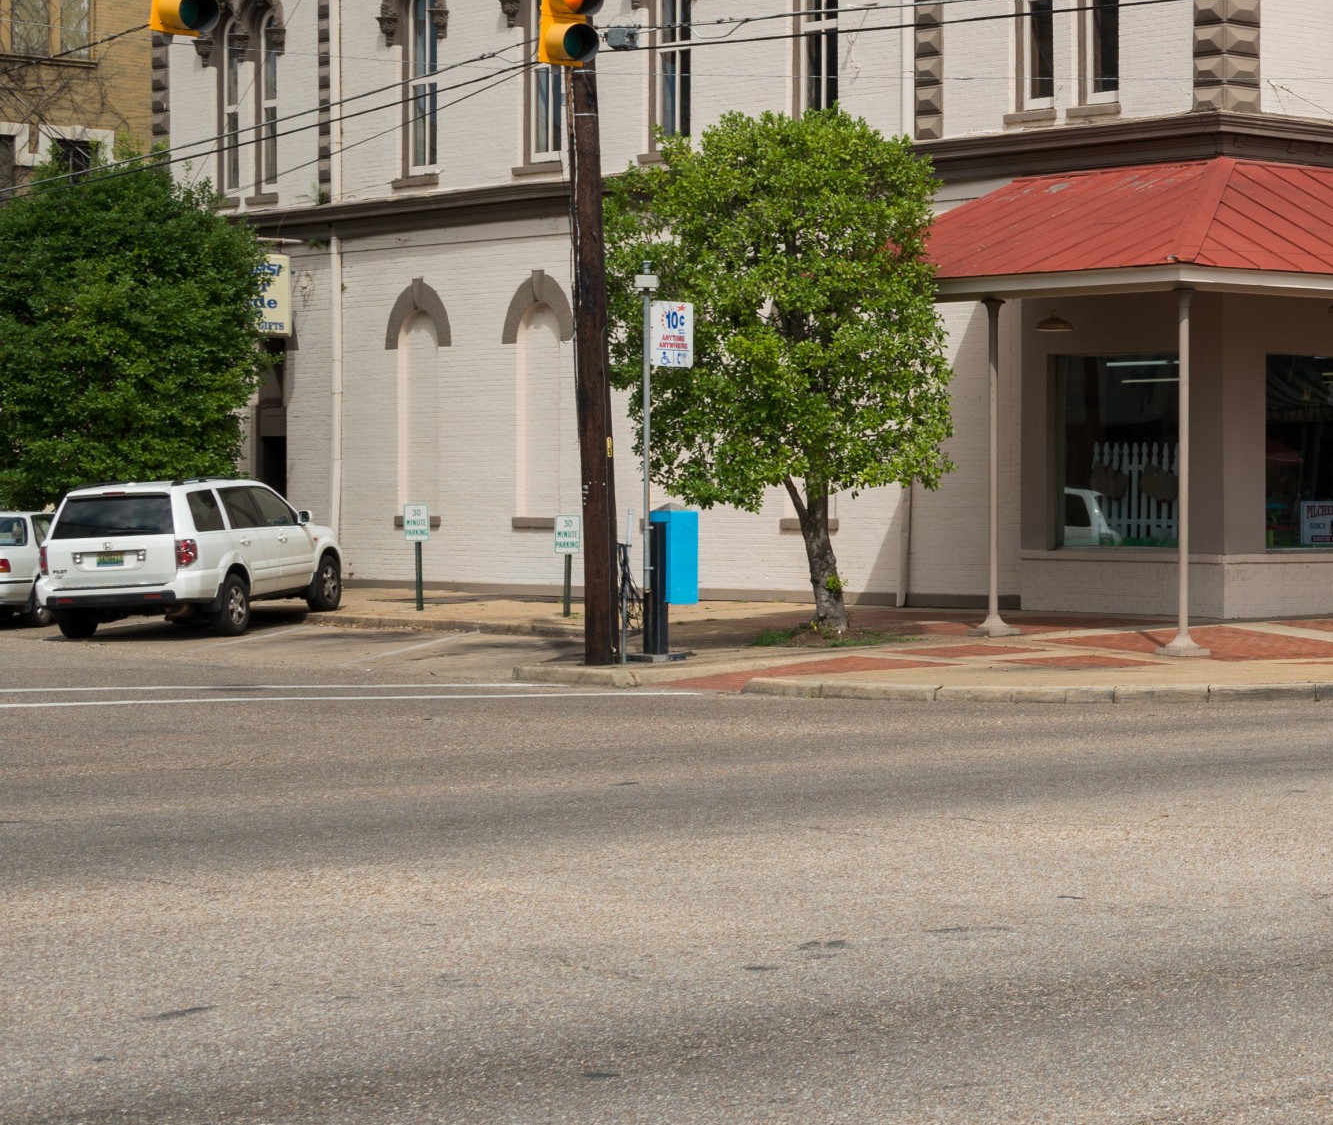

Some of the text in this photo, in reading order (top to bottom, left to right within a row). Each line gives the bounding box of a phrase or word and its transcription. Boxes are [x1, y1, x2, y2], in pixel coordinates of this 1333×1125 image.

[662, 334, 685, 342] ANYTIME
[412, 508, 421, 516] 30
[564, 519, 573, 527] 30
[557, 530, 578, 538] MINUTE
[556, 541, 579, 549] PARKING
